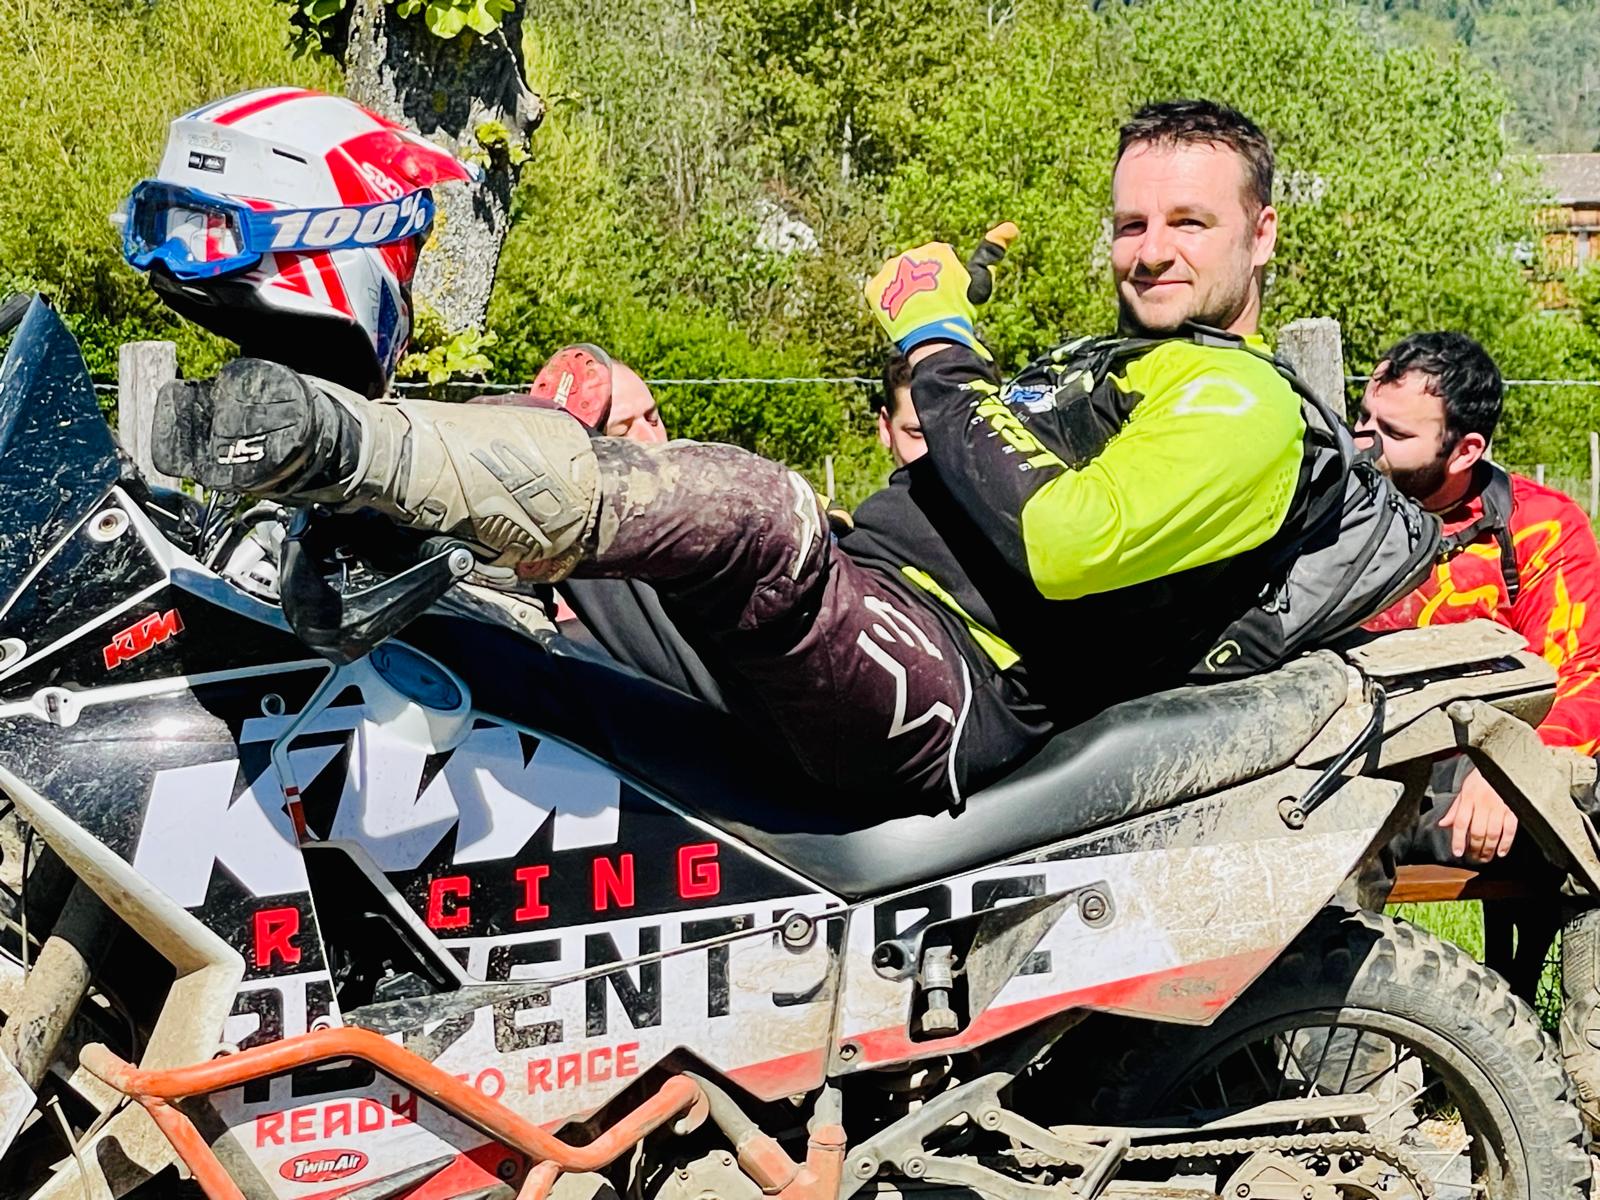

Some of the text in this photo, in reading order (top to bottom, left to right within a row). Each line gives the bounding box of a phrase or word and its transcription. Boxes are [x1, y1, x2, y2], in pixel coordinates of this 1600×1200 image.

[271, 188, 426, 250] 100%
[103, 608, 185, 670] KTM
[133, 702, 621, 908] KTM
[253, 842, 721, 967] RCING
[255, 1091, 417, 1148] READY
[526, 1042, 639, 1095] RACE
